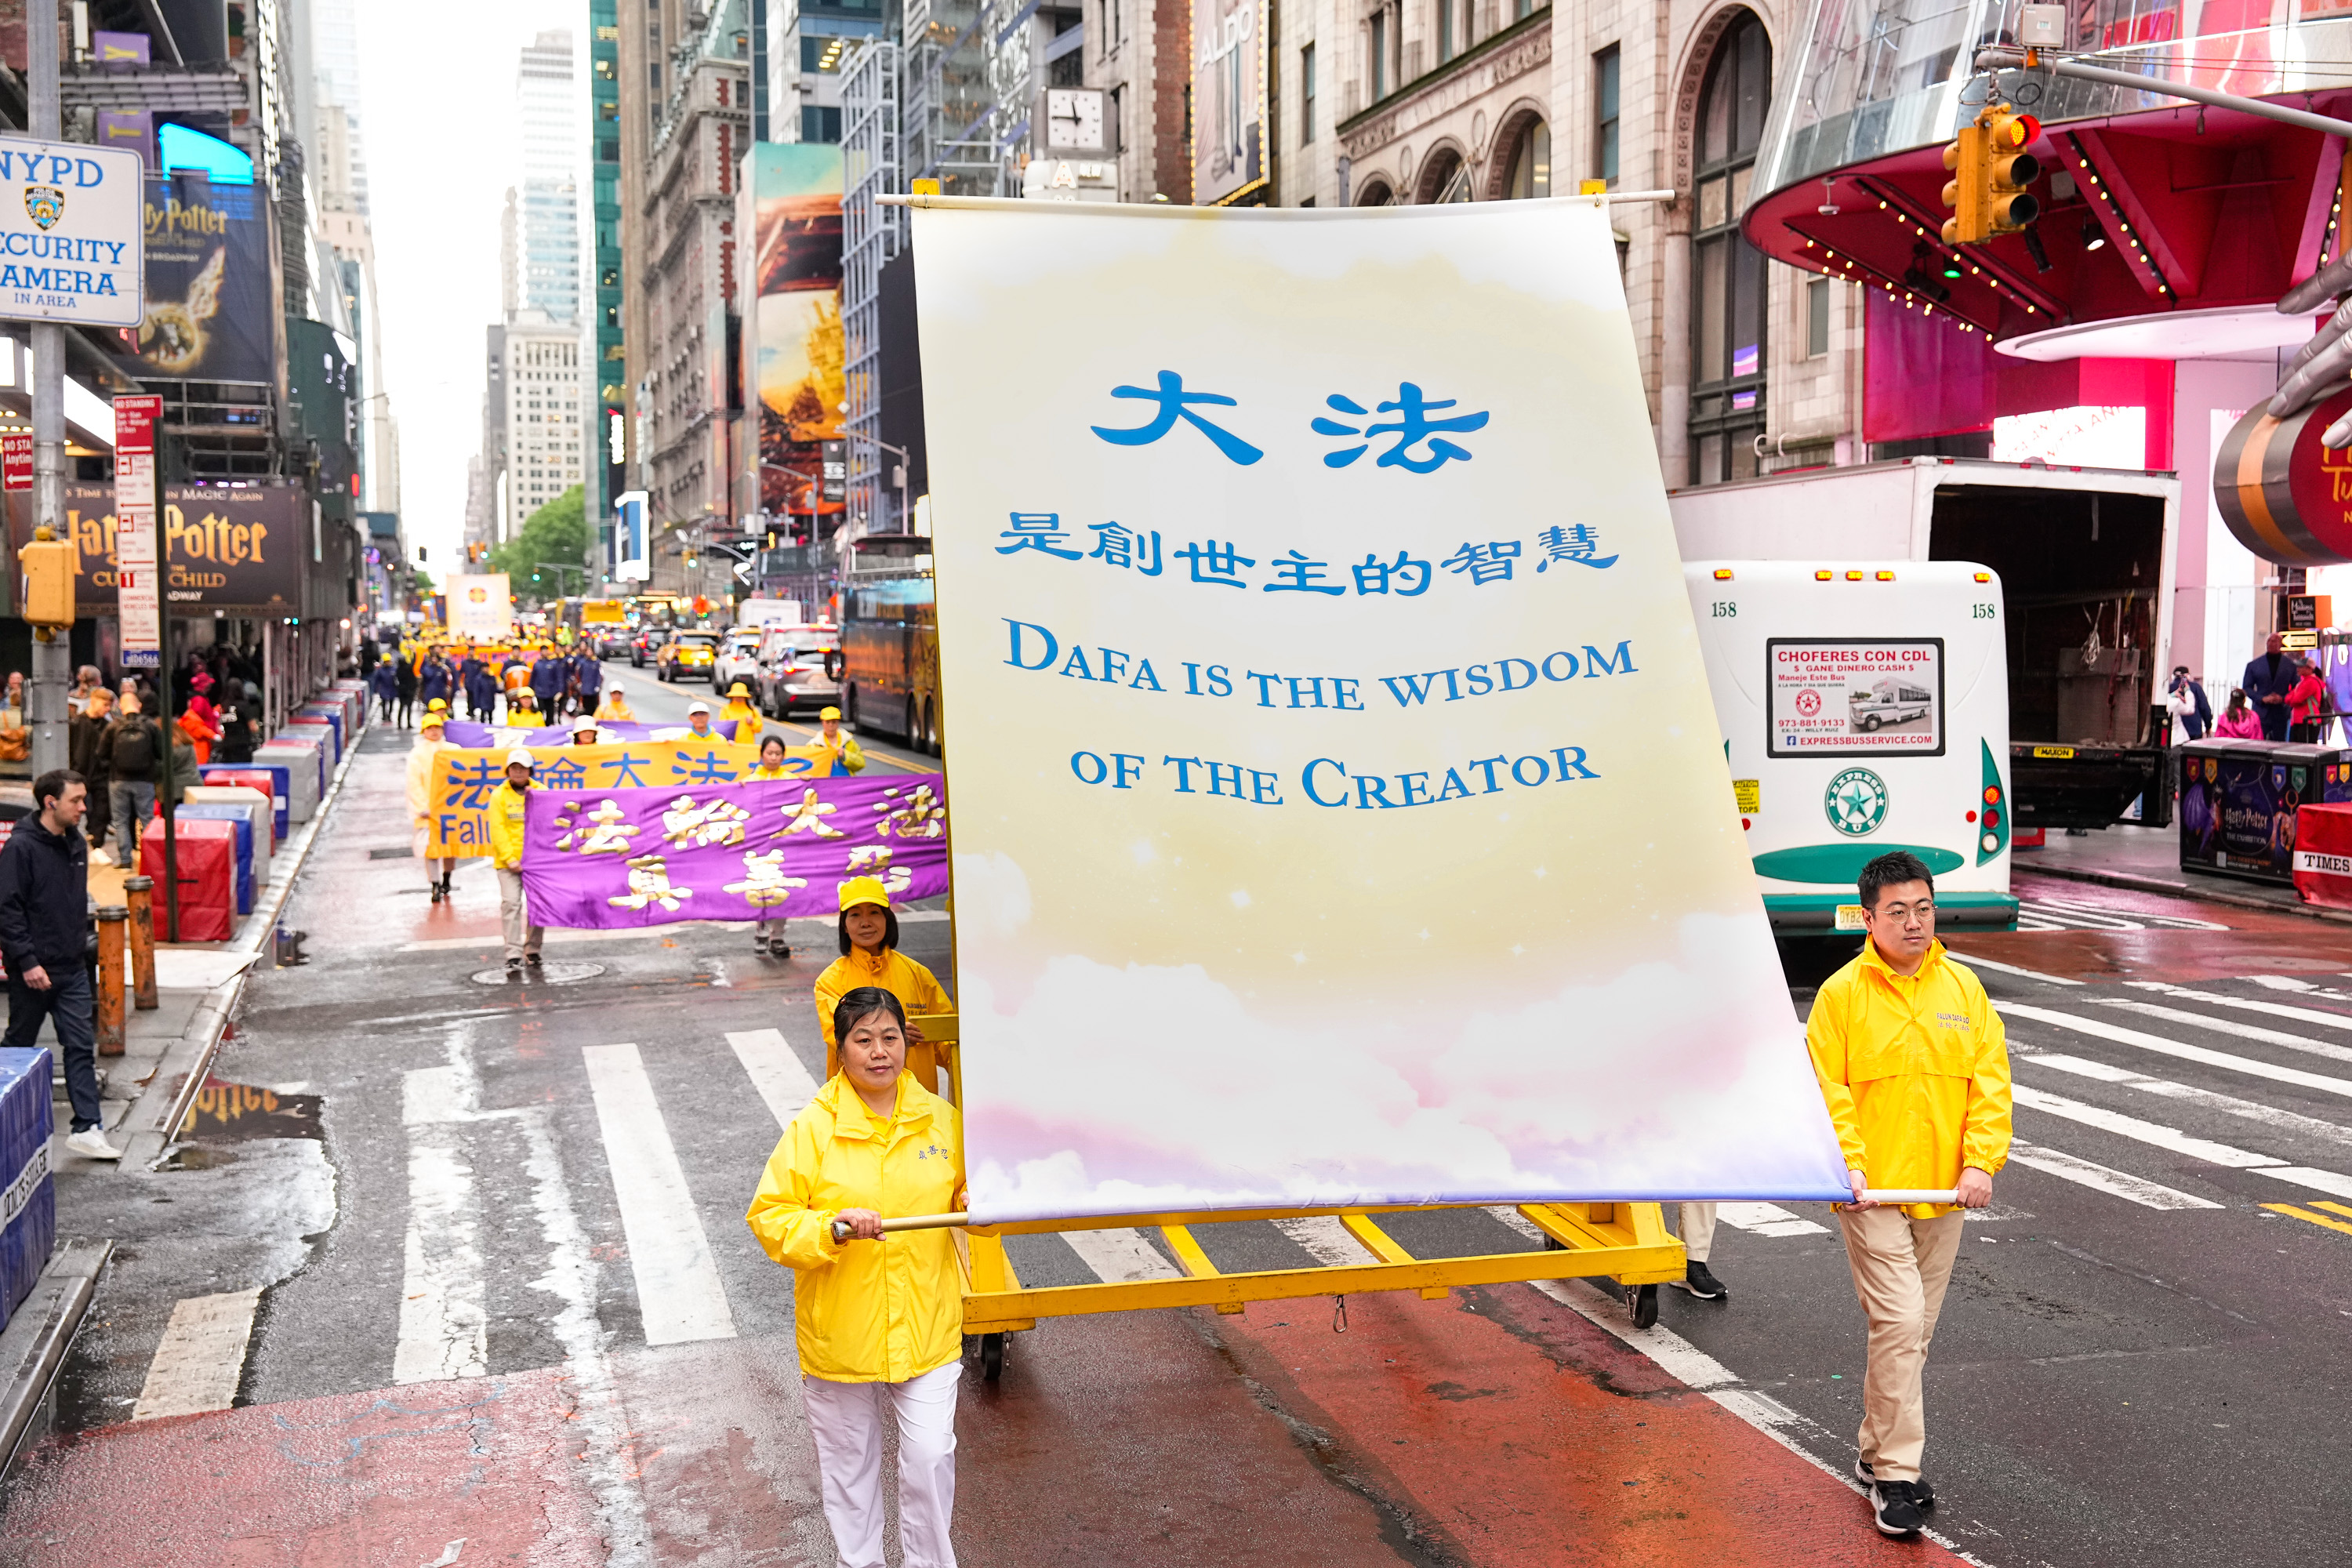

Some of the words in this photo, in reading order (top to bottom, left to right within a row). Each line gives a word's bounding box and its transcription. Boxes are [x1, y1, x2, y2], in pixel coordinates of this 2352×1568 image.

[1199, 3, 1254, 71] ALDO
[0, 264, 118, 296] AMERA
[14, 292, 31, 303] IN
[35, 295, 77, 308] AREA
[1091, 371, 1490, 474] 大法
[4, 440, 16, 452] NO
[16, 438, 32, 452] STA
[5, 452, 32, 466] Anytim
[182, 488, 227, 501] MAGIC
[230, 492, 263, 502] AGAIN
[165, 503, 268, 567] Potter
[996, 512, 1618, 596] 是創世主的智慧
[168, 572, 227, 589] CHILD
[1711, 601, 1737, 618] 158
[1972, 604, 1995, 619] 158
[1778, 651, 1859, 662] CHOFERES
[1864, 651, 1896, 662] CON
[1901, 651, 1931, 661] CDL
[1182, 662, 1233, 697] IS
[1247, 670, 1365, 711] THE
[1379, 641, 1638, 707] WISDOM
[1800, 736, 1932, 746] EXPRESSBUSSERVICE.COM
[1071, 751, 1145, 789] OF
[1163, 755, 1283, 805] THE
[1831, 771, 1883, 795] EXPRESS
[441, 815, 489, 844] Fal
[1837, 818, 1877, 833] BUS
[2304, 854, 2350, 872] TIMES
